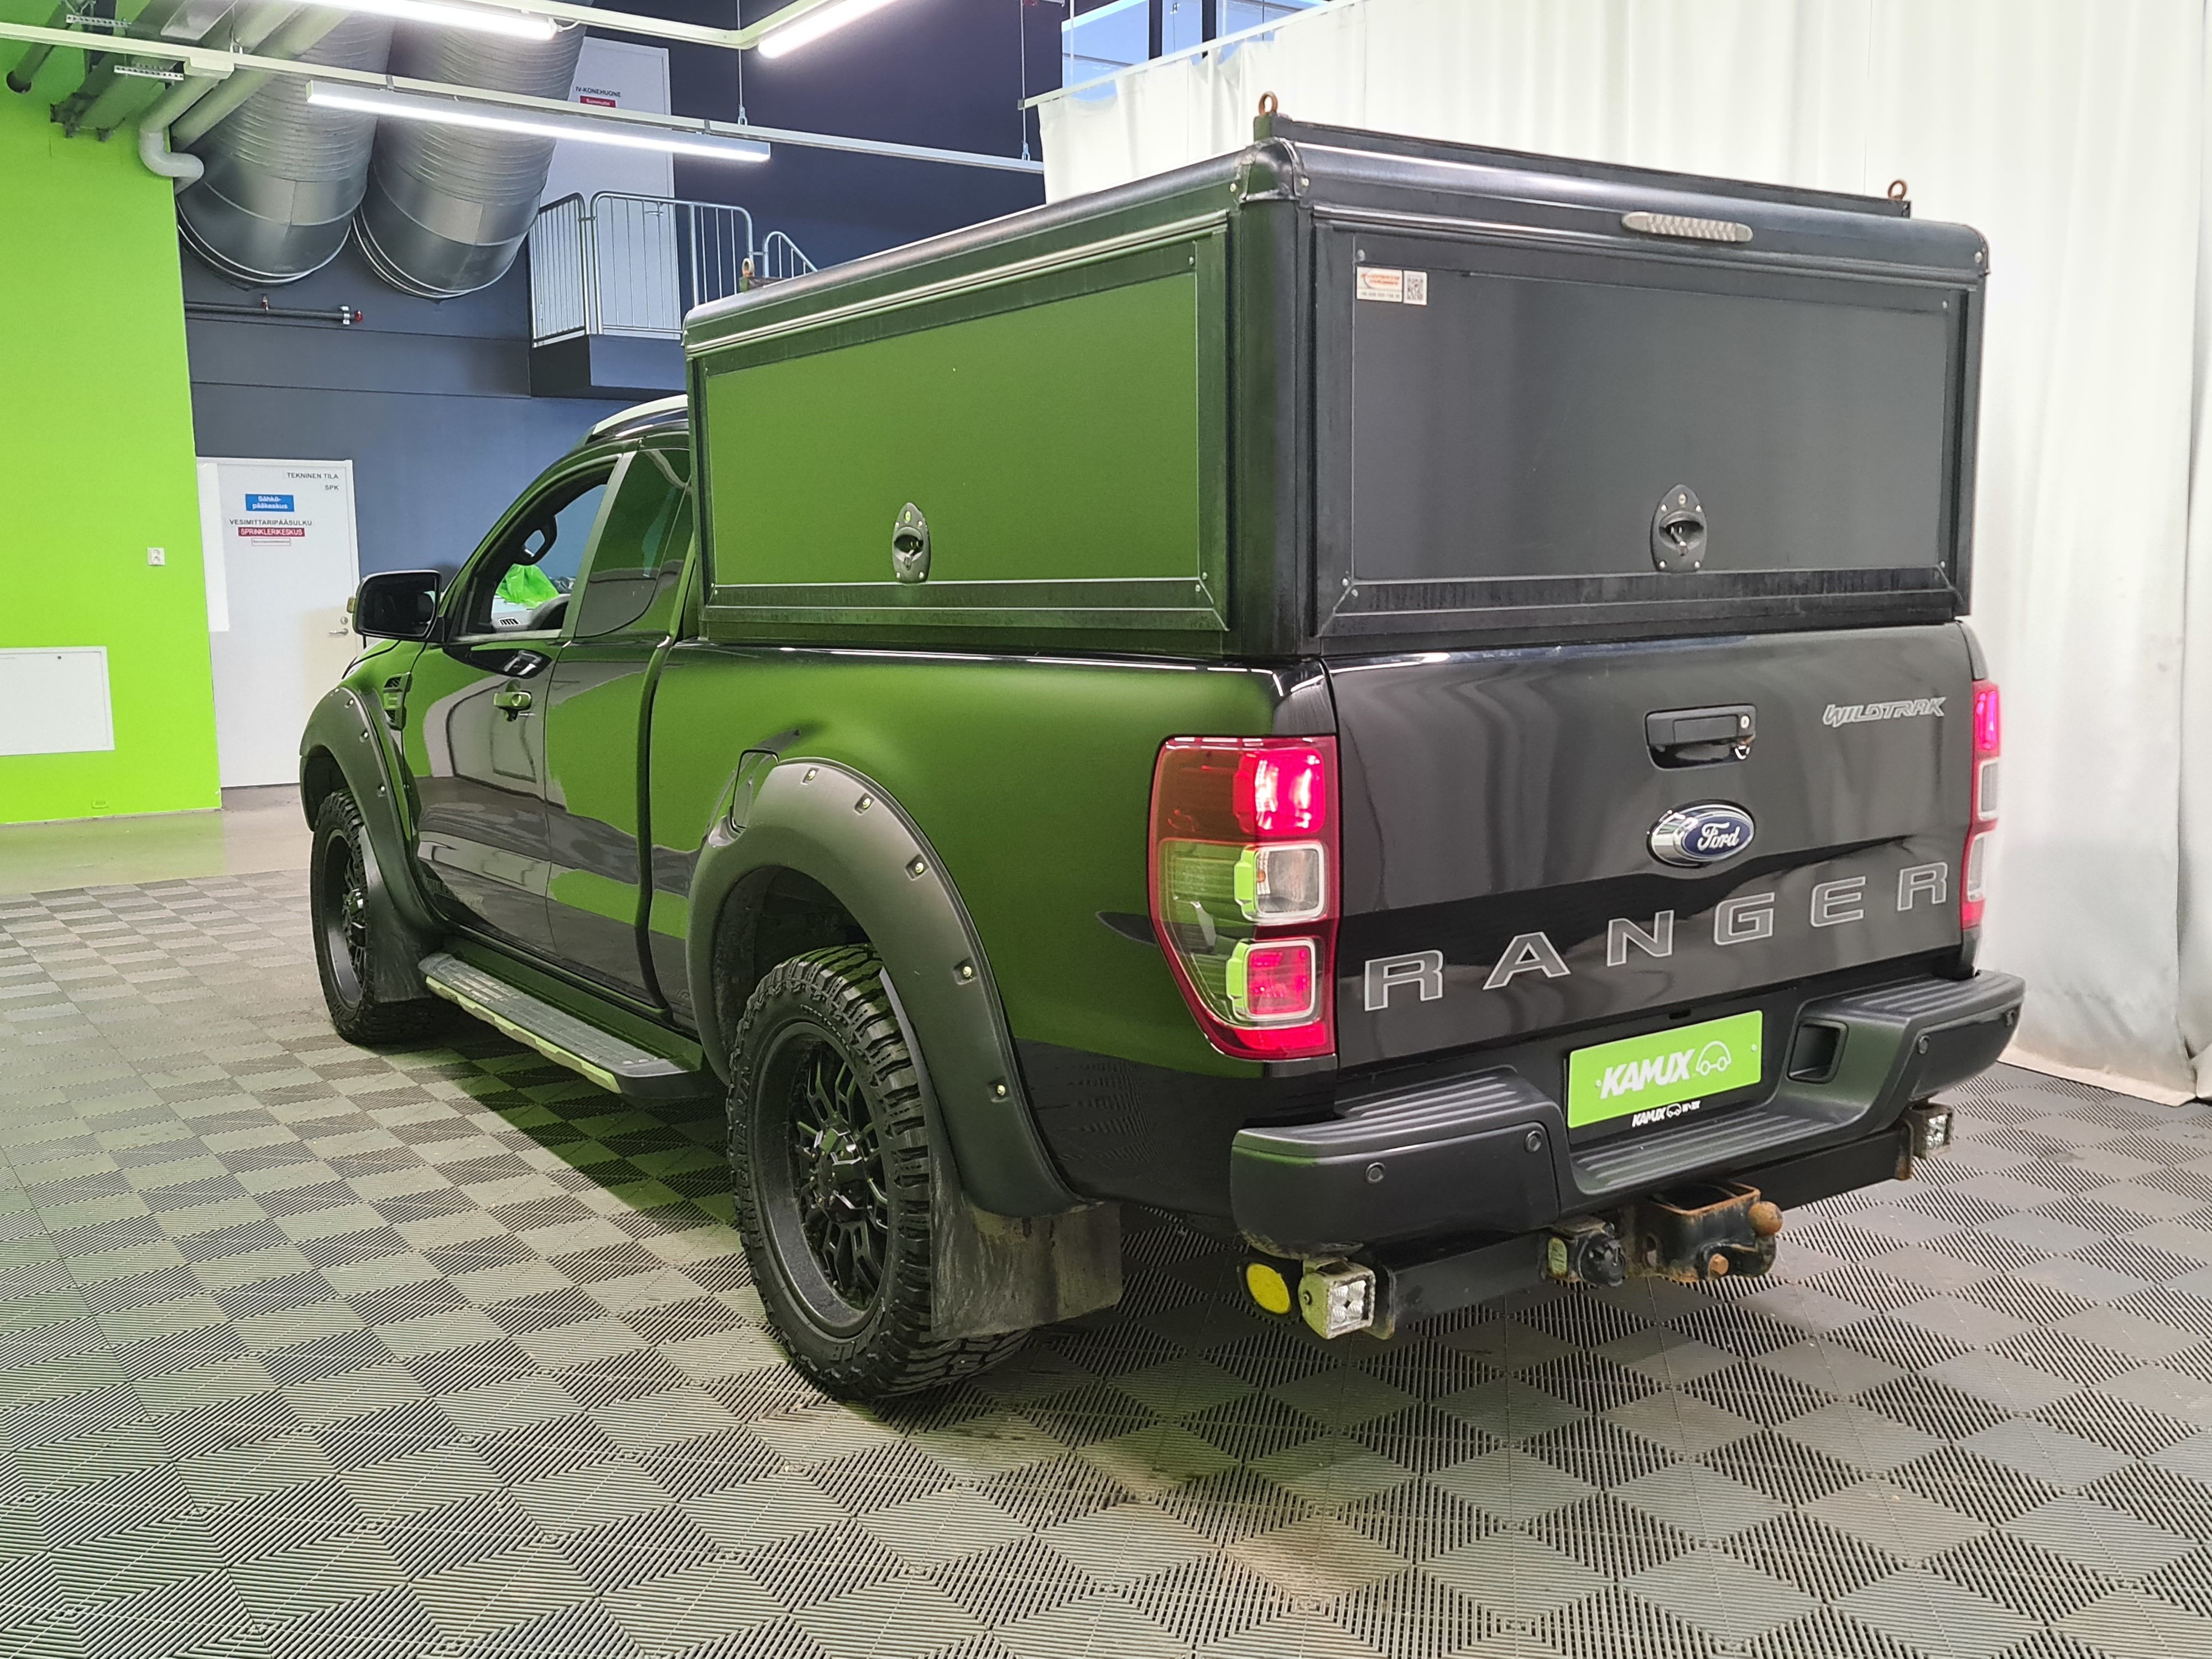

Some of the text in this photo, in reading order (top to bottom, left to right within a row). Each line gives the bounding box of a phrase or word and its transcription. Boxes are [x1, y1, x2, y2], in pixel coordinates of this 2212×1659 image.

[1822, 696, 1947, 728] WILDTRAK
[1697, 822, 1740, 851] Ford
[1364, 862, 1949, 1011] RANGER
[1600, 1048, 1696, 1099] KAMUX
[1632, 1107, 1666, 1128] KAMUX
